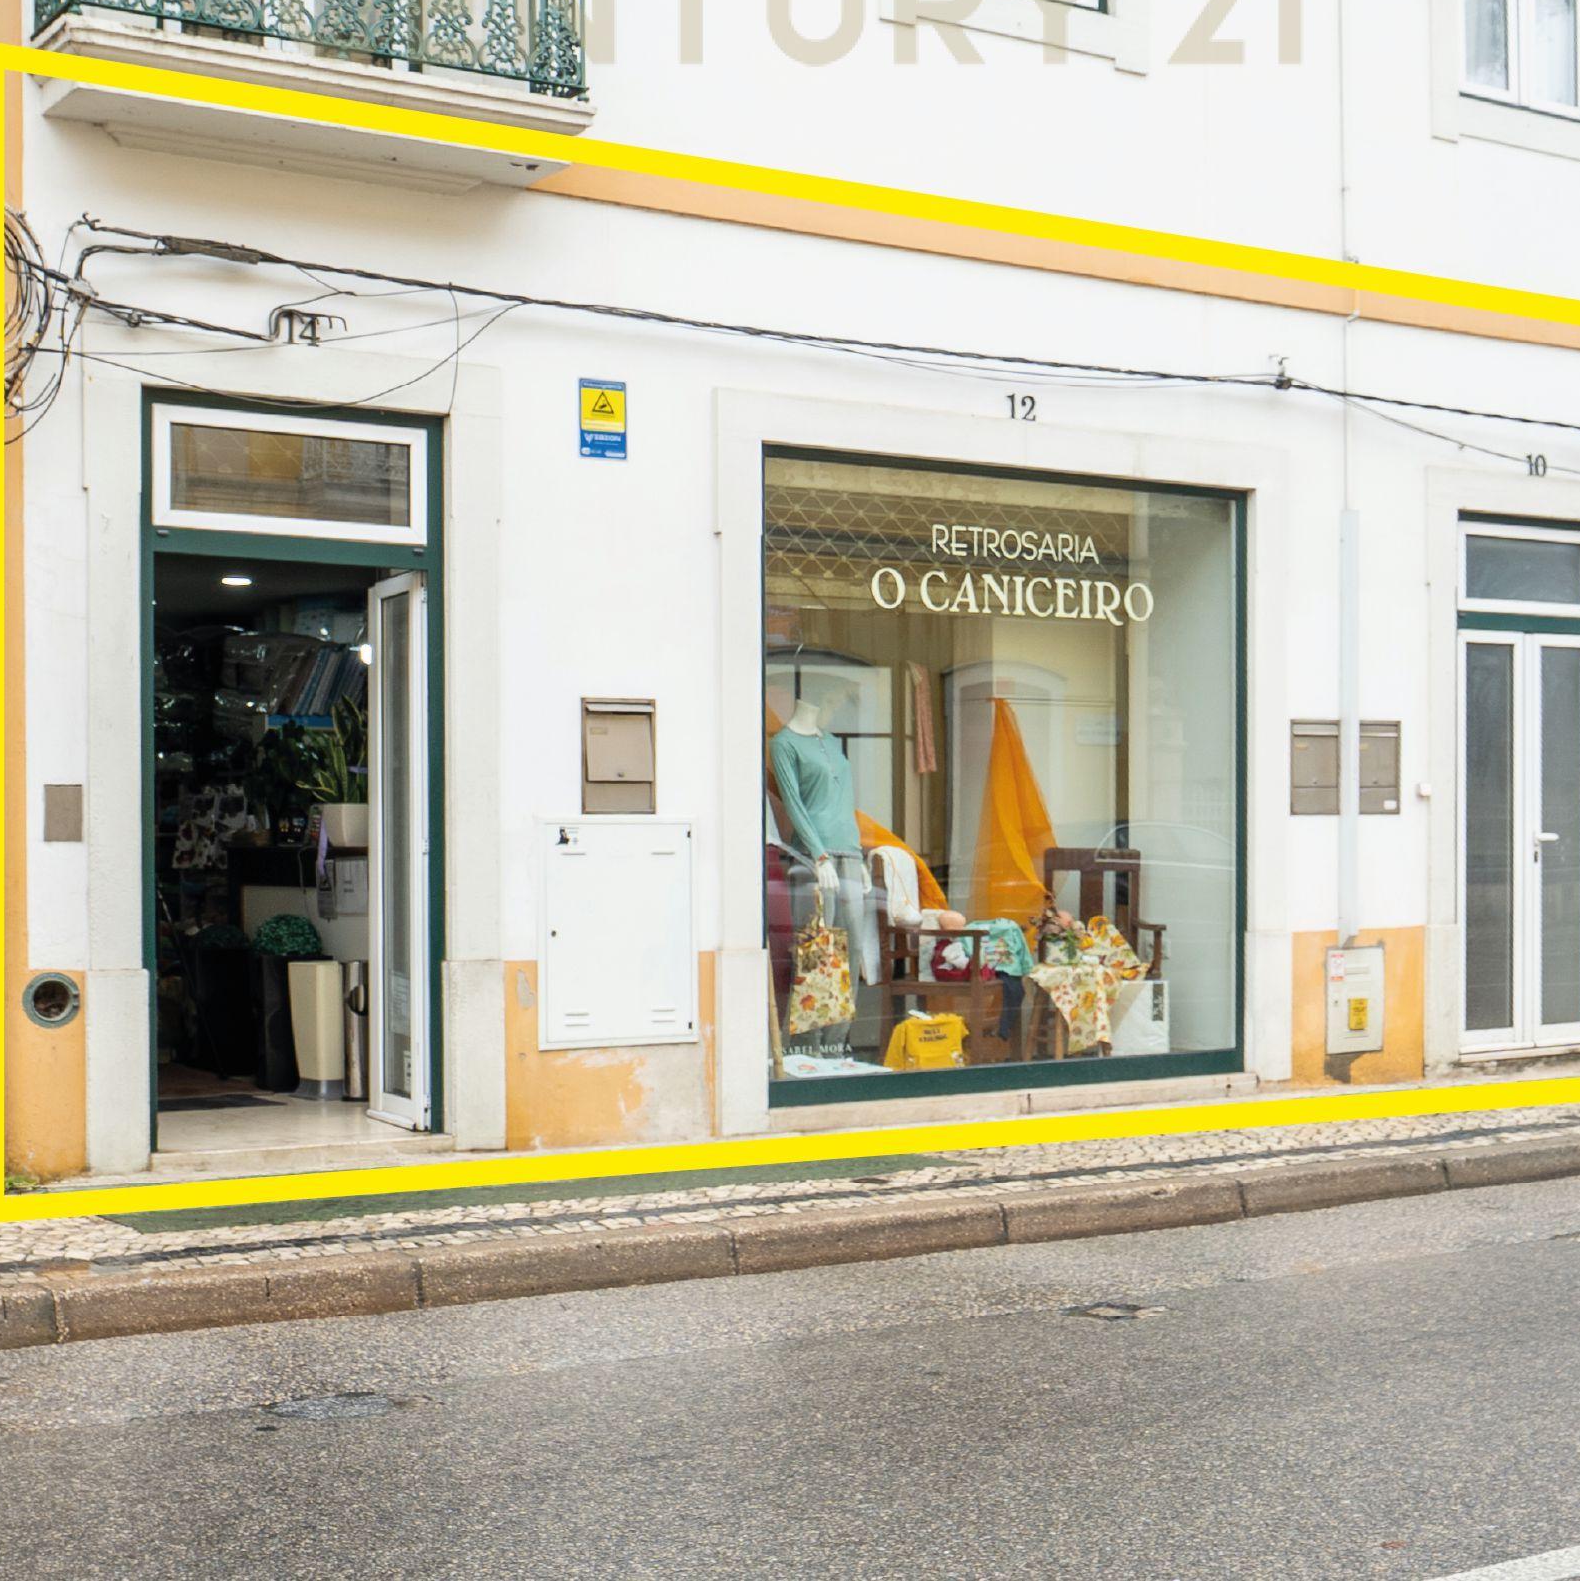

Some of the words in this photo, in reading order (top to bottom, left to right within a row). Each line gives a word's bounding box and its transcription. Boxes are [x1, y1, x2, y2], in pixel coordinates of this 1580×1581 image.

[1006, 393, 1036, 421] 12
[1526, 454, 1547, 477] 10
[932, 524, 1099, 564] RETROSARIA
[871, 567, 906, 609] O
[920, 570, 1154, 626] CANICEIRO
